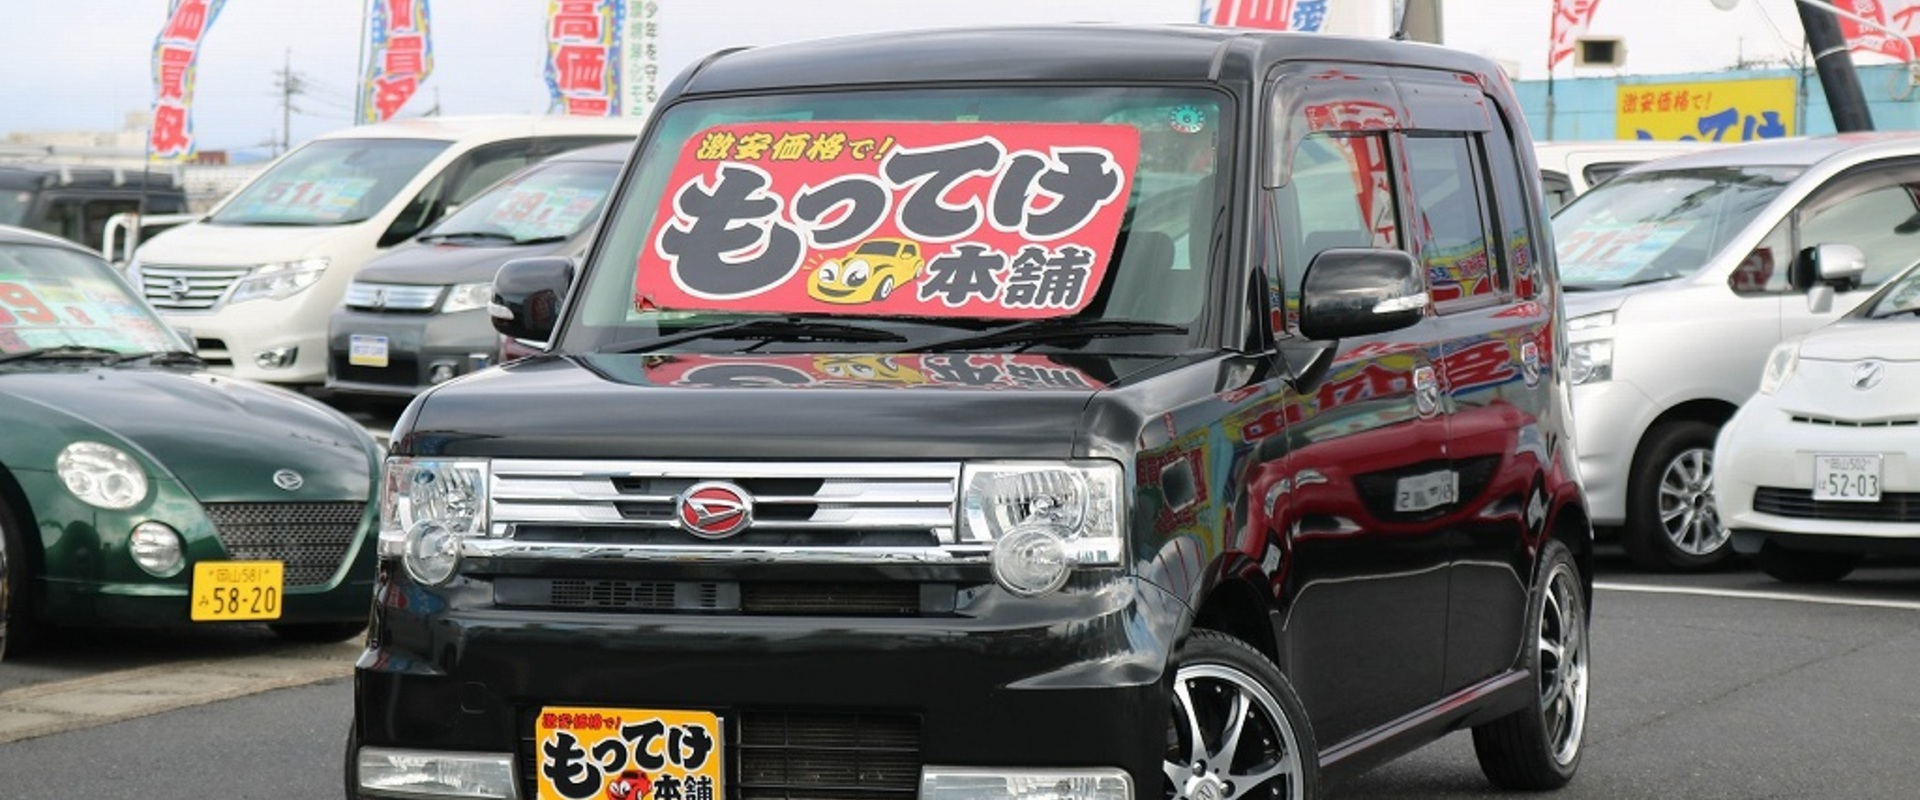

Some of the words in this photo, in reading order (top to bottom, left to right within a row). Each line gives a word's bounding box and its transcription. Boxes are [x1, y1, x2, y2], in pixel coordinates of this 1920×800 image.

[657, 136, 1125, 299] もってけ
[917, 244, 1098, 308] 本舗
[1829, 473, 1878, 497] 52-03
[213, 586, 276, 614] 58-20
[542, 718, 715, 800] もってけ
